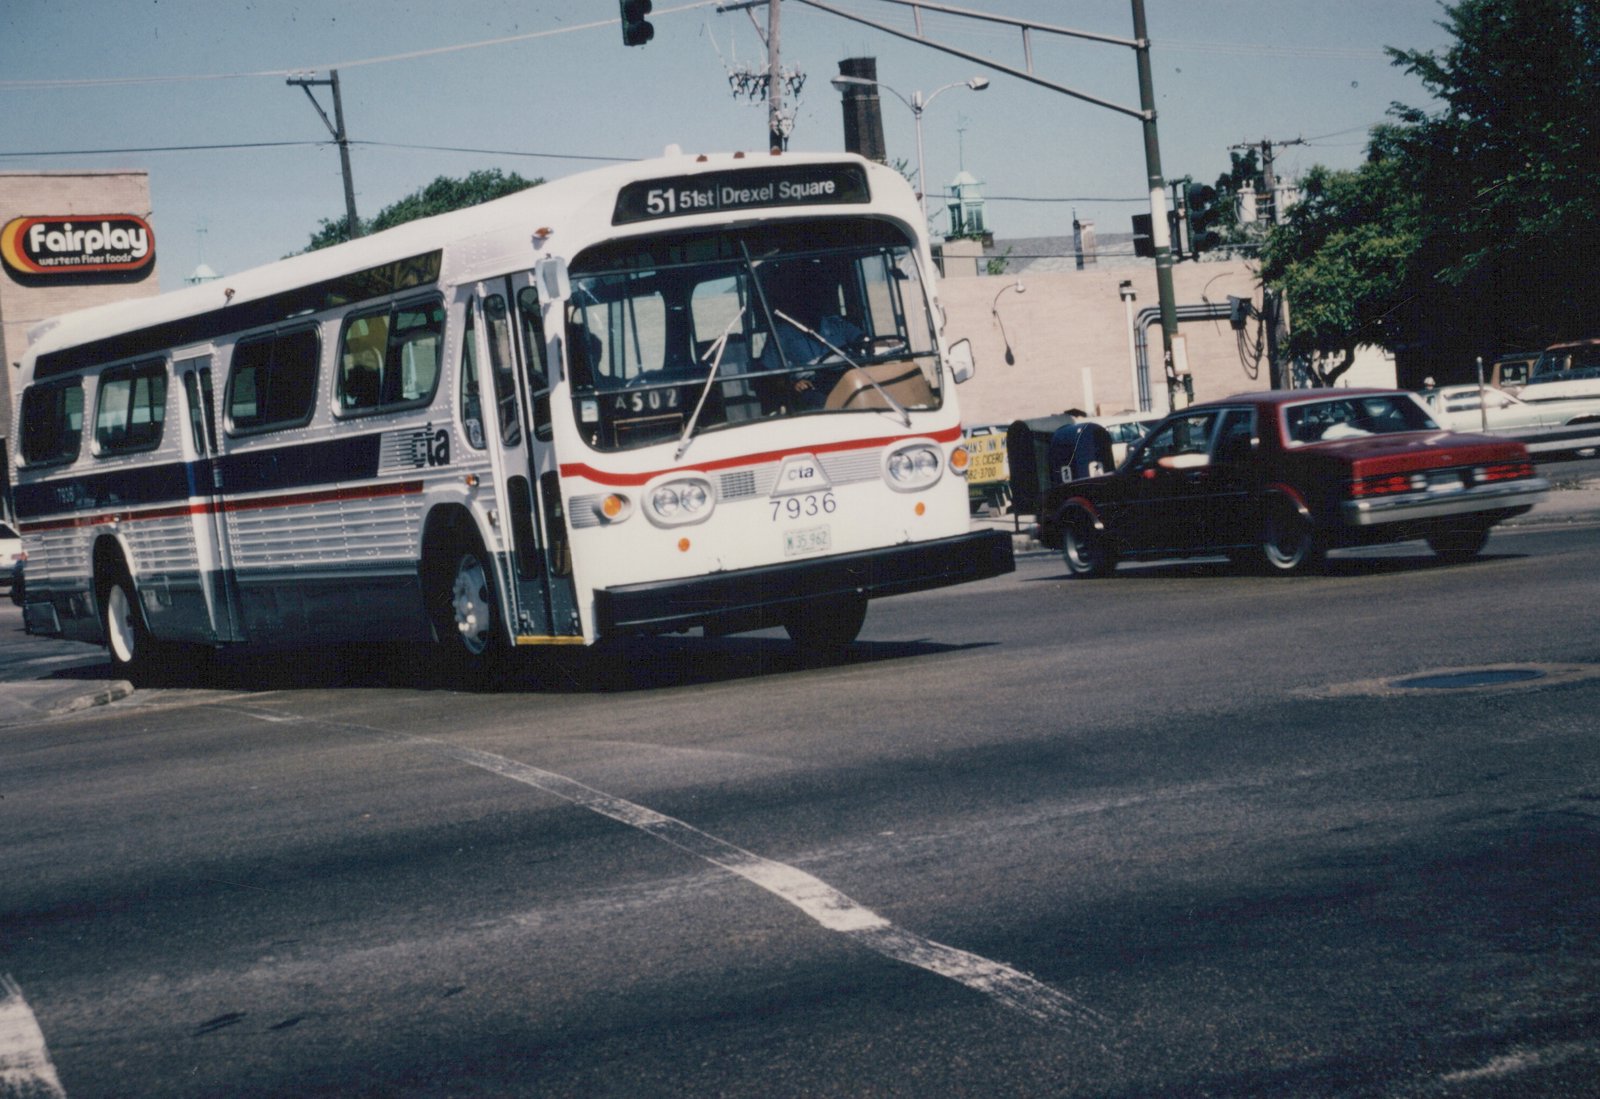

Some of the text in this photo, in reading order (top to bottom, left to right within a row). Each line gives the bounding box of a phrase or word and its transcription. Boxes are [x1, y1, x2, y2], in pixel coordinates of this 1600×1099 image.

[646, 180, 835, 214] 51 51st Drexel Square
[39, 256, 81, 266] western
[106, 253, 132, 263] foods
[769, 492, 837, 521] 7936
